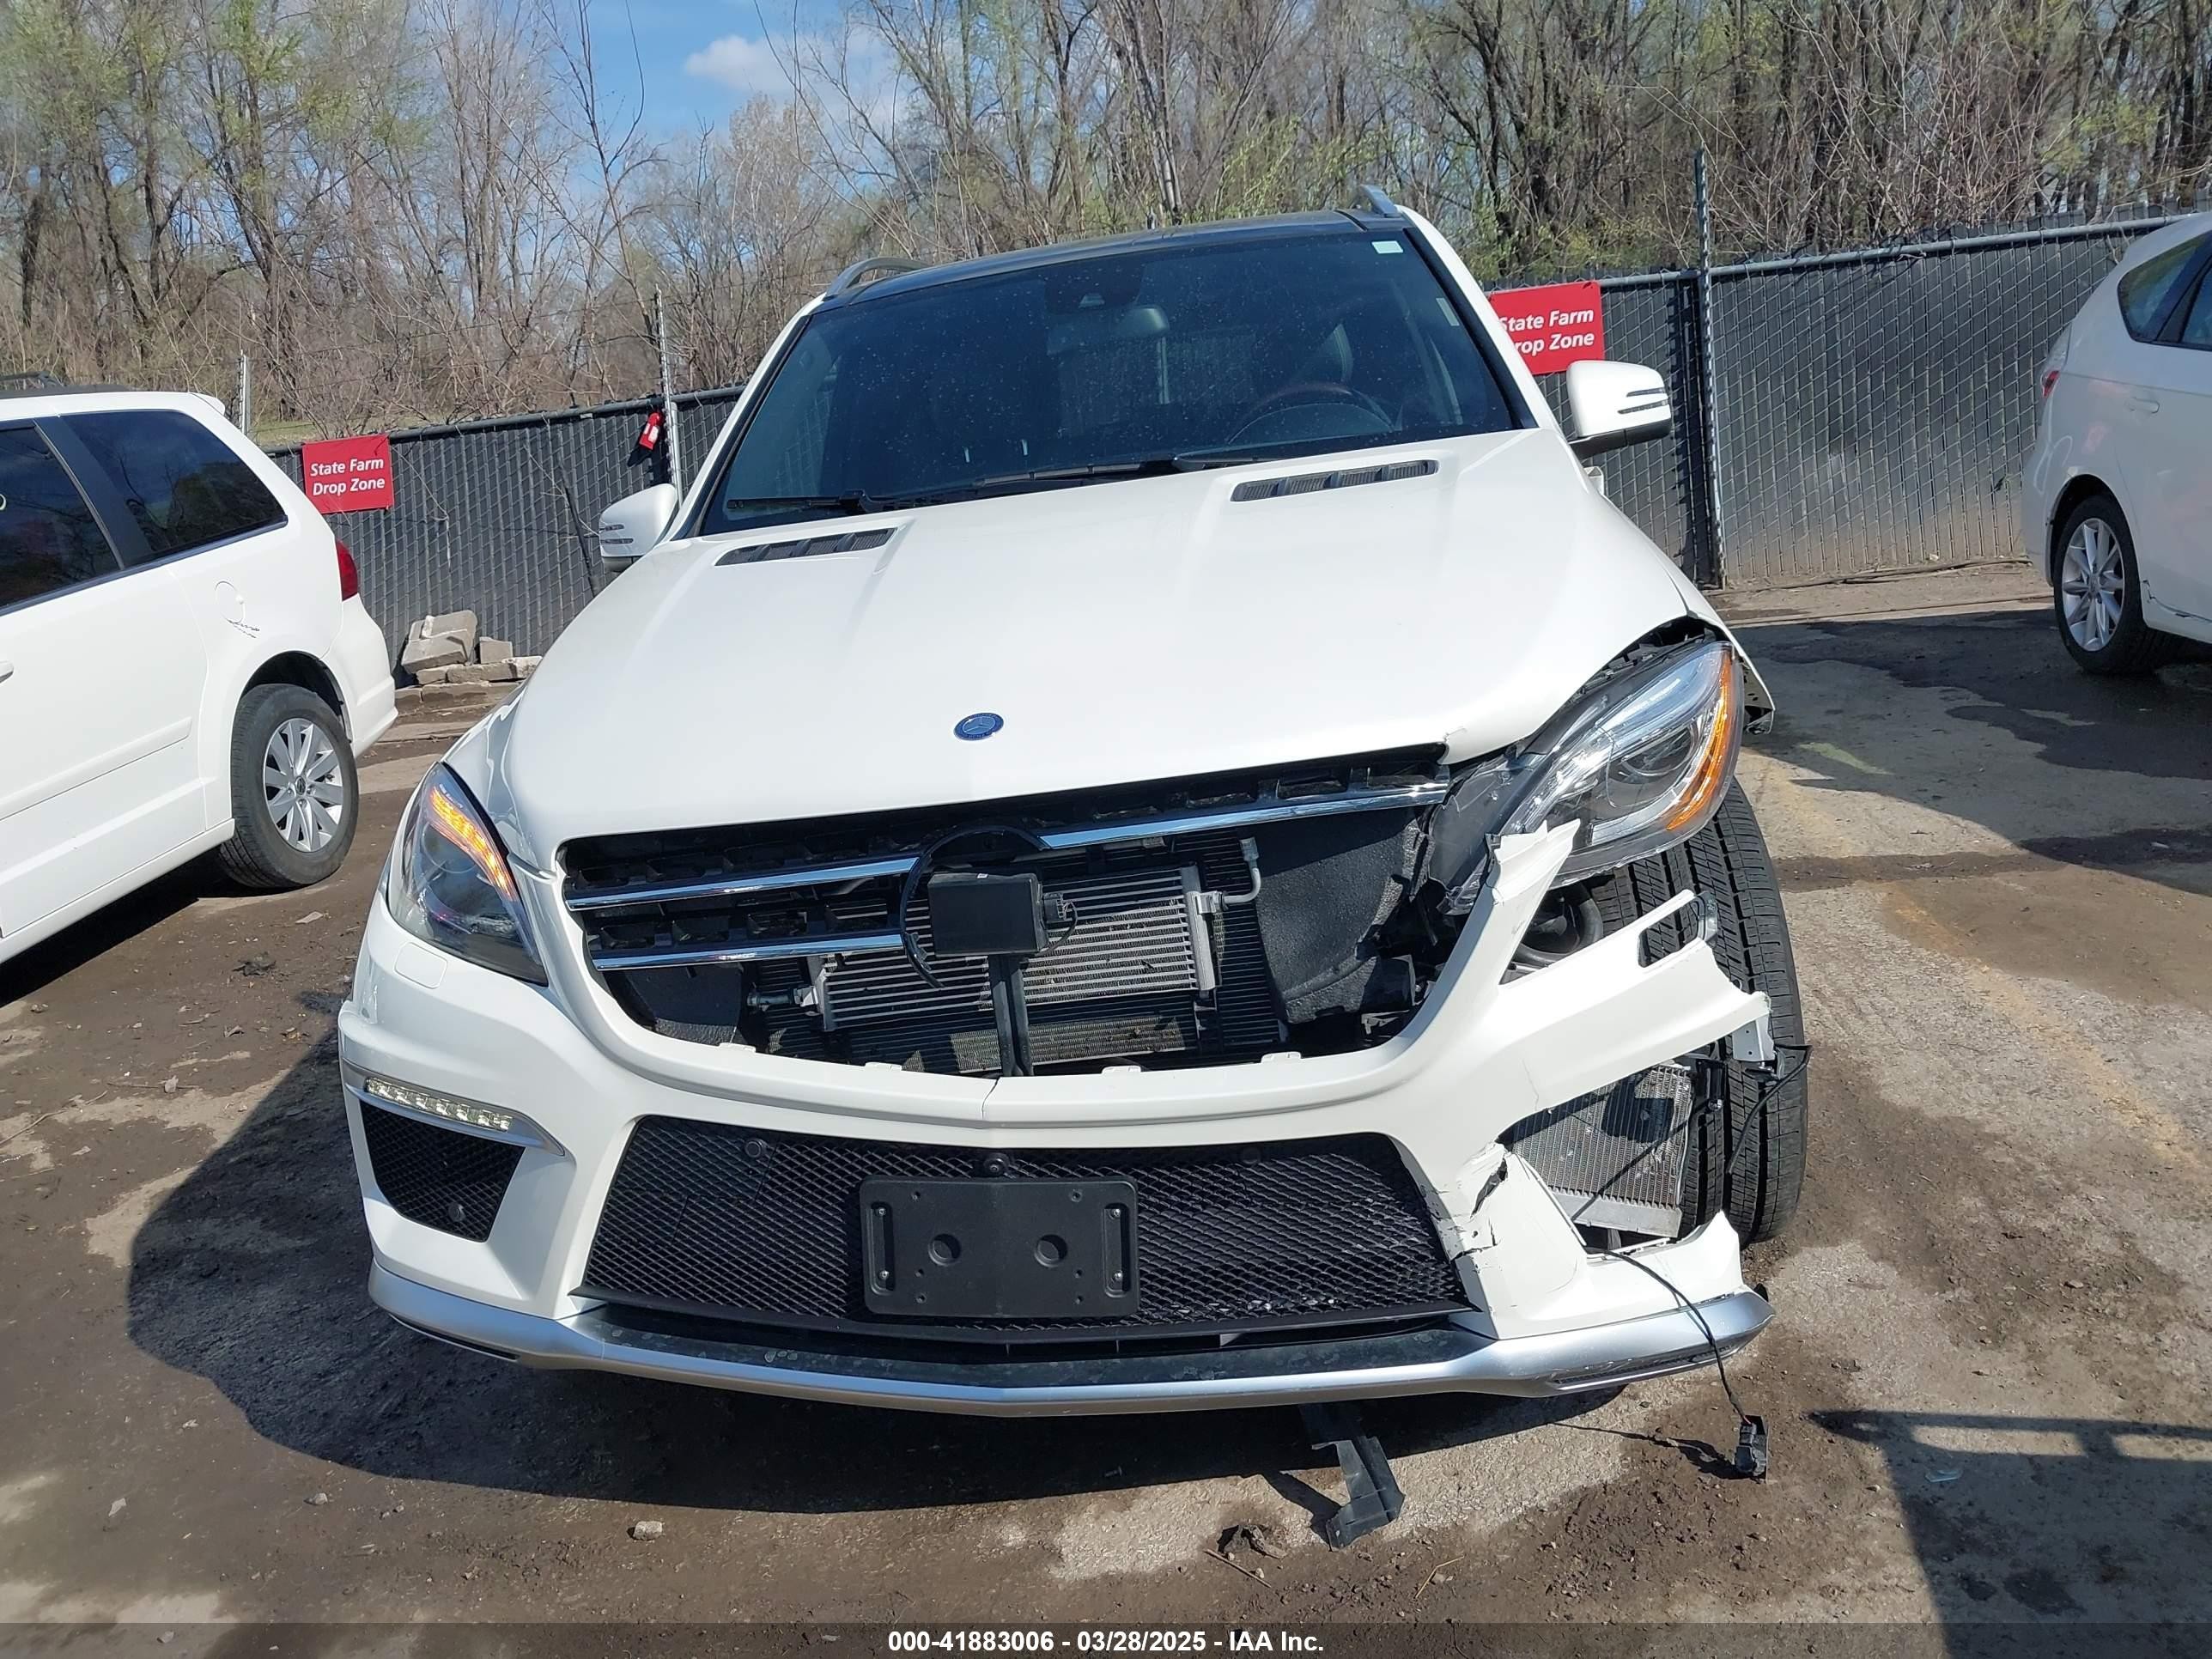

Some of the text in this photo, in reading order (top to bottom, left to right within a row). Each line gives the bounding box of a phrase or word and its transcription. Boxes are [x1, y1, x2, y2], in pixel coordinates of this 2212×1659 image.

[1549, 309, 1594, 327] Farm
[1516, 333, 1595, 357] rop Zone
[310, 459, 384, 477] State Farm
[313, 478, 385, 496] Drop Zone
